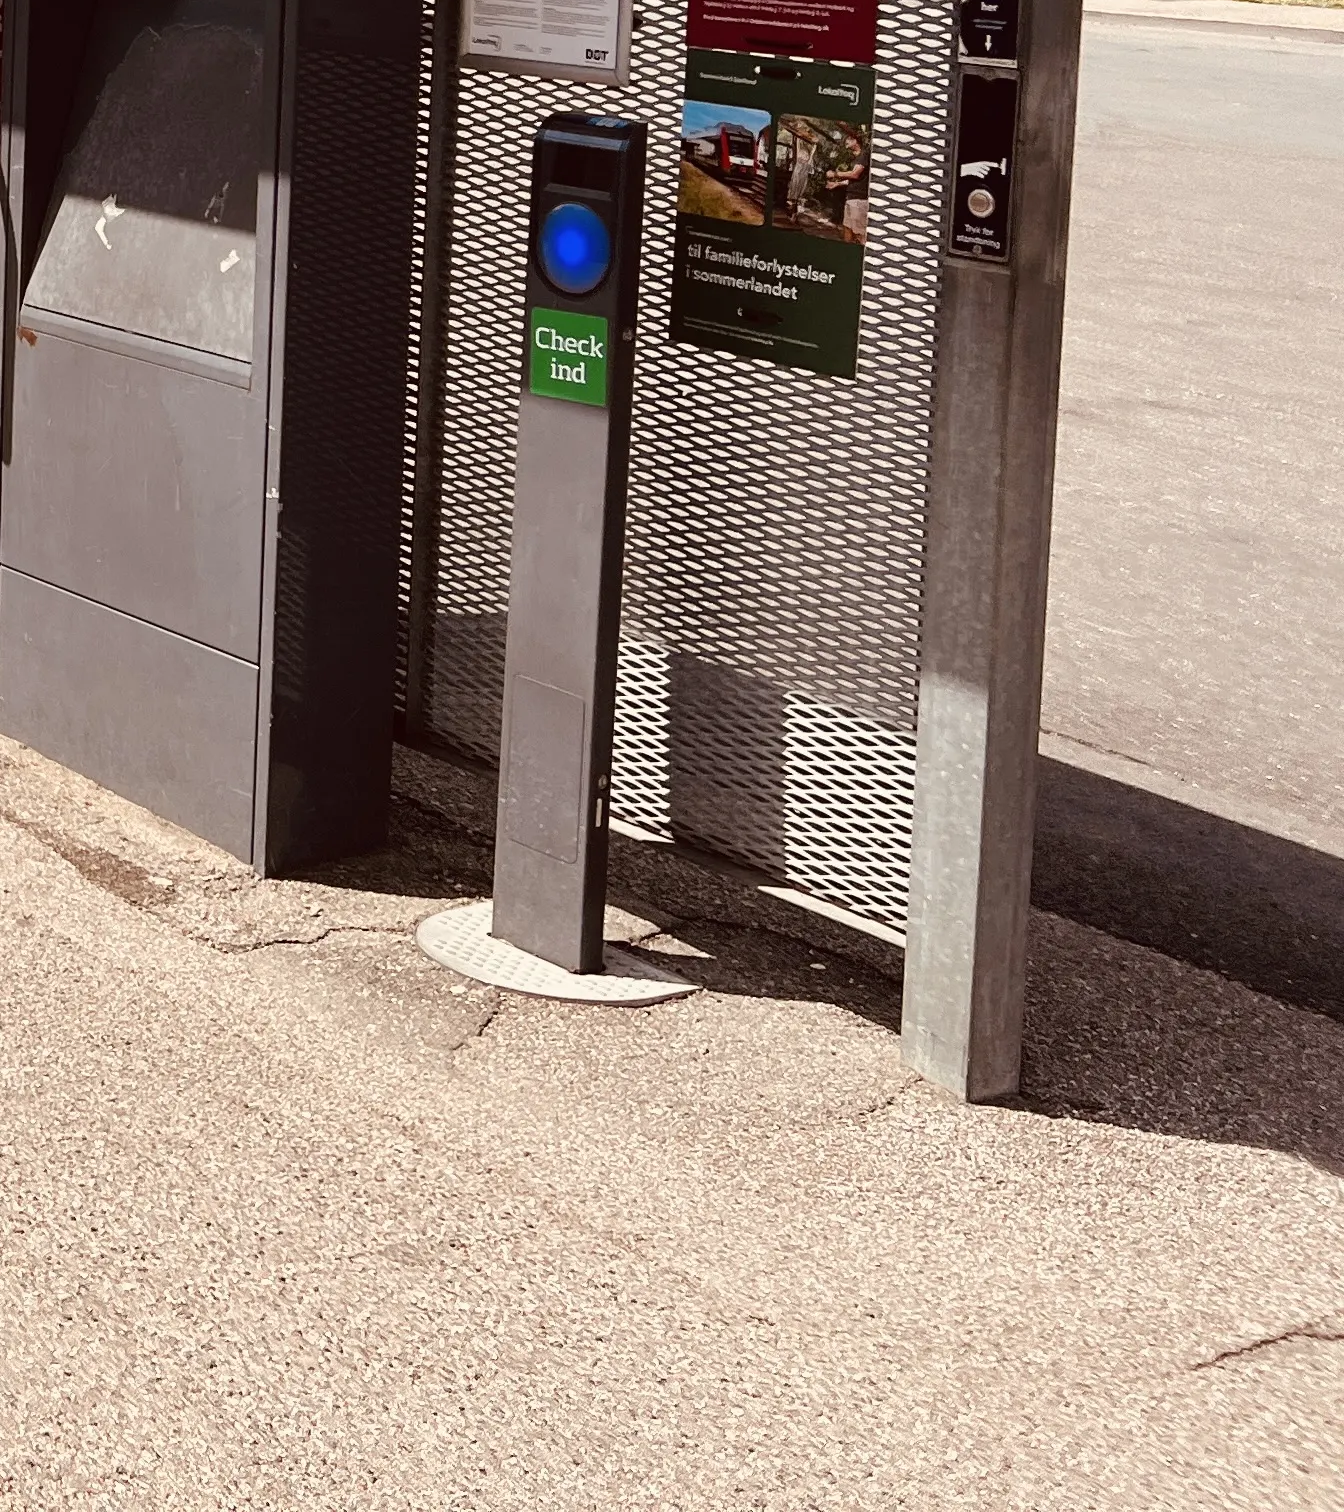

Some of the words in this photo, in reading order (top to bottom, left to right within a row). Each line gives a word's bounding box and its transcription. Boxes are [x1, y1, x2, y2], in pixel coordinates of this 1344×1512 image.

[585, 48, 609, 62] DOT
[687, 244, 701, 258] til
[705, 245, 836, 284] familieforlystelser
[685, 264, 691, 278] i
[693, 268, 798, 300] sommerlandet
[535, 326, 604, 359] Check
[550, 357, 586, 384] ind
